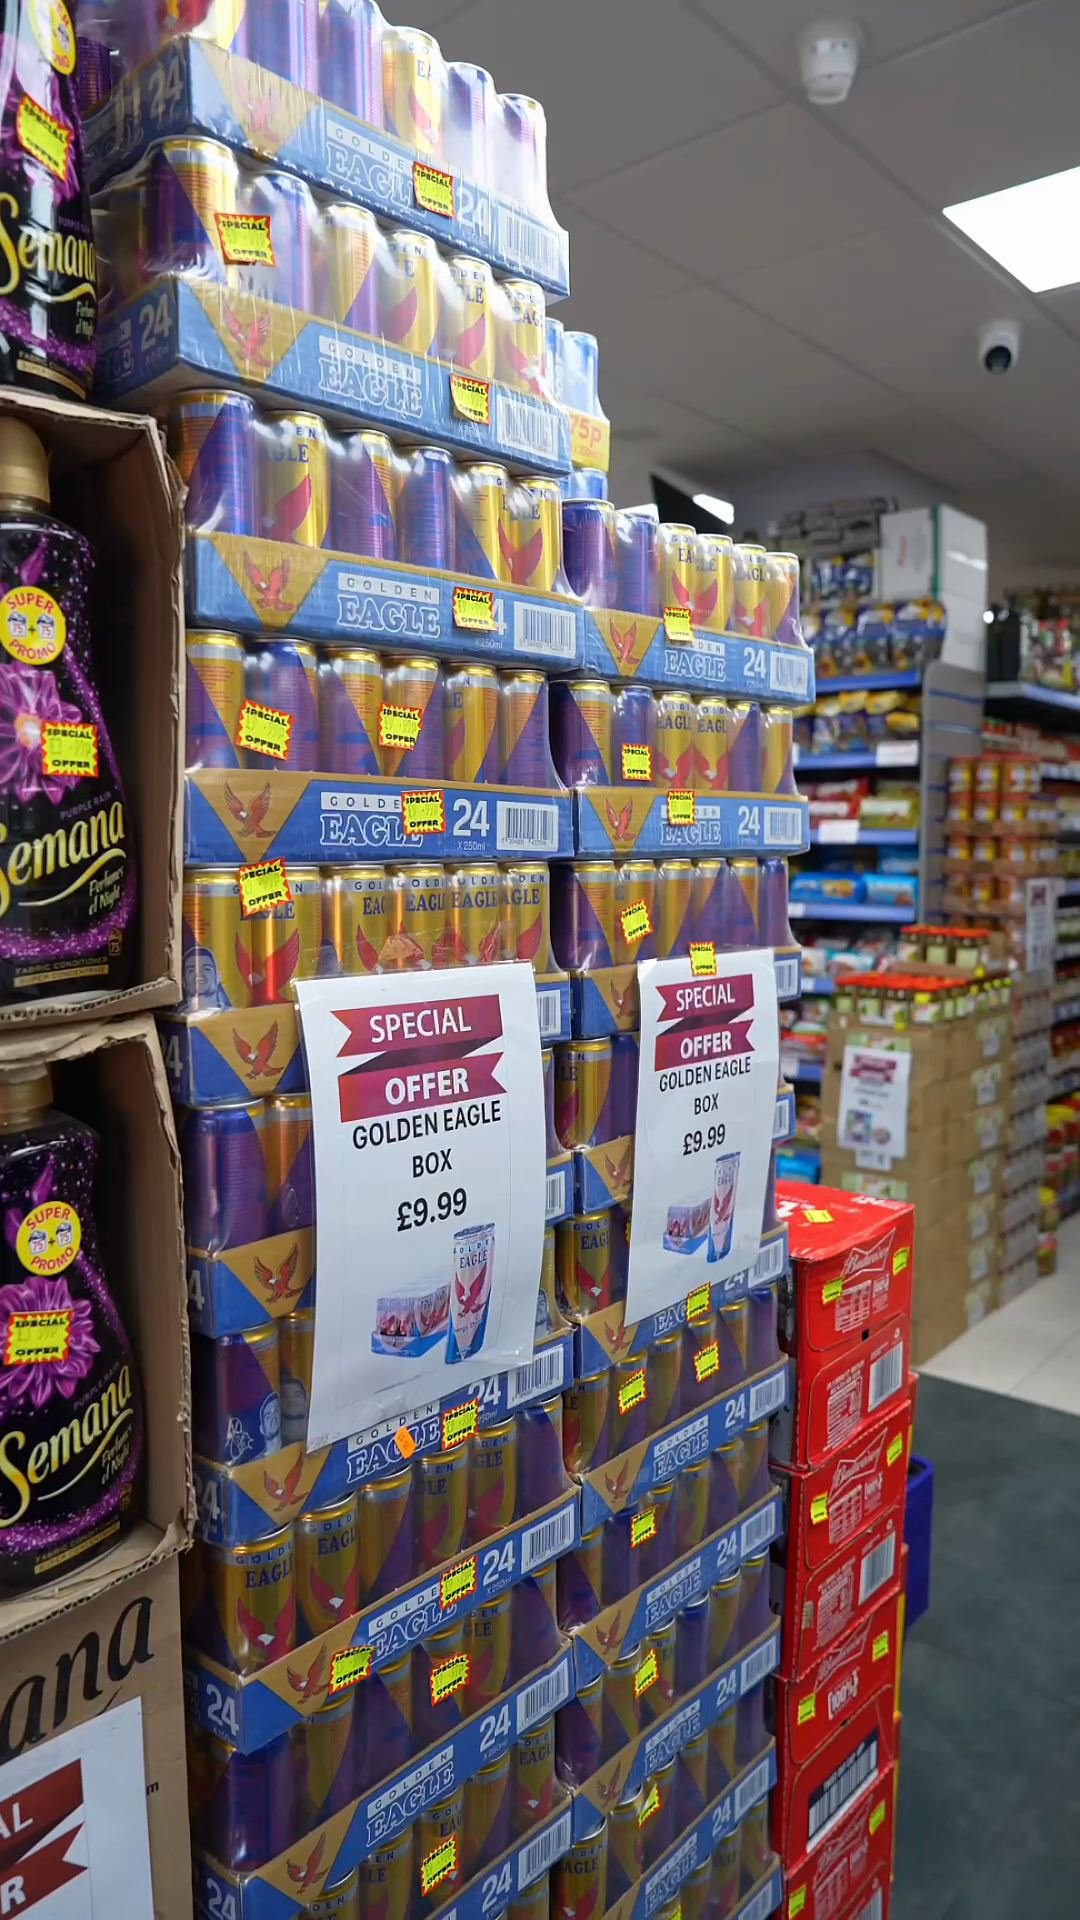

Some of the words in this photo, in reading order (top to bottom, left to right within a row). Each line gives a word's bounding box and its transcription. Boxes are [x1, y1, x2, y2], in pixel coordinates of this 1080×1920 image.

[23, 103, 66, 144] SPECIAL
[336, 128, 405, 171] GOLDE
[416, 169, 450, 188] SPECIAL
[421, 195, 450, 211] OFFER
[221, 219, 265, 231] SPECIAL
[233, 248, 268, 259] OFFER
[141, 295, 173, 350] 24
[328, 341, 414, 378] GOLDEN
[318, 356, 422, 418] EAGLE
[454, 378, 488, 396] SPECIAL
[459, 405, 484, 417] OFFER
[347, 577, 432, 599] GOLDEN
[457, 592, 490, 604] SPECIAL
[7, 593, 54, 613] SUPER
[337, 595, 440, 637] EAGLE
[461, 616, 489, 626] OFFER
[9, 639, 56, 659] PROMO
[664, 649, 726, 681] EAGLE
[743, 647, 766, 679] 24
[246, 707, 287, 725] SPECIAL
[383, 709, 418, 720] SPECIAL
[48, 729, 92, 740] SPECIAL
[245, 735, 282, 751] OFFER
[385, 733, 416, 743] OFFER
[624, 748, 647, 756] SPECIAL
[52, 759, 90, 768] OFFER
[627, 768, 647, 776] OFFER
[330, 796, 400, 809] GOLDE
[406, 796, 439, 804] SPECIAL
[409, 819, 438, 828] OFFER
[453, 798, 489, 837] 24
[738, 806, 760, 836] 24
[661, 821, 721, 845] EAGLE
[243, 866, 280, 880] SPECIAL
[248, 890, 282, 907] OFFER
[623, 905, 645, 918] SPECIAL
[627, 924, 647, 937] OFFER
[676, 983, 735, 1012] SPECIAL
[370, 1006, 472, 1043] SPECIAL
[680, 1030, 731, 1059] OFFER
[660, 1066, 712, 1092] GOLDEN
[715, 1057, 751, 1077] EAGLE
[385, 1067, 469, 1105] OFFER
[694, 1093, 719, 1115] BOX
[353, 1111, 438, 1149] GOLDEN
[444, 1100, 501, 1131] EAGLE
[683, 1124, 726, 1156] £9.99
[413, 1148, 452, 1178] BOX
[26, 1207, 70, 1230] SUPER
[397, 1187, 467, 1231] £9.99
[32, 1240, 44, 1250] 75
[59, 1233, 70, 1242] 75
[31, 1247, 74, 1271] PROMO
[460, 1249, 488, 1269] EAGLE
[689, 1286, 709, 1298] SPECIAL
[15, 1317, 66, 1327] SPECIAL
[16, 1346, 58, 1356] OFFER
[697, 1347, 716, 1361] SPECIAL
[700, 1364, 715, 1376] OFFER
[621, 1374, 642, 1389] SPECIAL
[468, 1376, 501, 1412] 24
[624, 1391, 641, 1404] OFFER
[445, 1405, 475, 1421] SPECIAL
[725, 1395, 745, 1427] 24
[356, 1405, 434, 1445] GOLDEN
[447, 1426, 472, 1441] OFFER
[657, 1420, 704, 1451] GOLDEN
[654, 1430, 709, 1480] EAGLE
[717, 1531, 737, 1568] 24
[443, 1561, 473, 1582] SPECIAL
[483, 1541, 515, 1587] 24
[446, 1583, 471, 1601] OFFER
[645, 1570, 701, 1628] EAGLE
[376, 1587, 438, 1629] GOLDE
[336, 1646, 373, 1662] SPECIAL
[336, 1666, 364, 1684] OFFER
[433, 1656, 465, 1677] SPECIAL
[436, 1676, 462, 1695] OFFER
[717, 1669, 737, 1707] 24
[206, 1683, 239, 1736] 24
[480, 1704, 511, 1753] 24
[644, 1714, 701, 1777] EAGLE
[375, 1752, 448, 1809] GOLDEN
[366, 1761, 455, 1847] EAGLE
[713, 1796, 731, 1838] 24
[423, 1839, 453, 1866] SPECIAL
[427, 1862, 452, 1885] OFFER
[482, 1862, 513, 1912] 24
